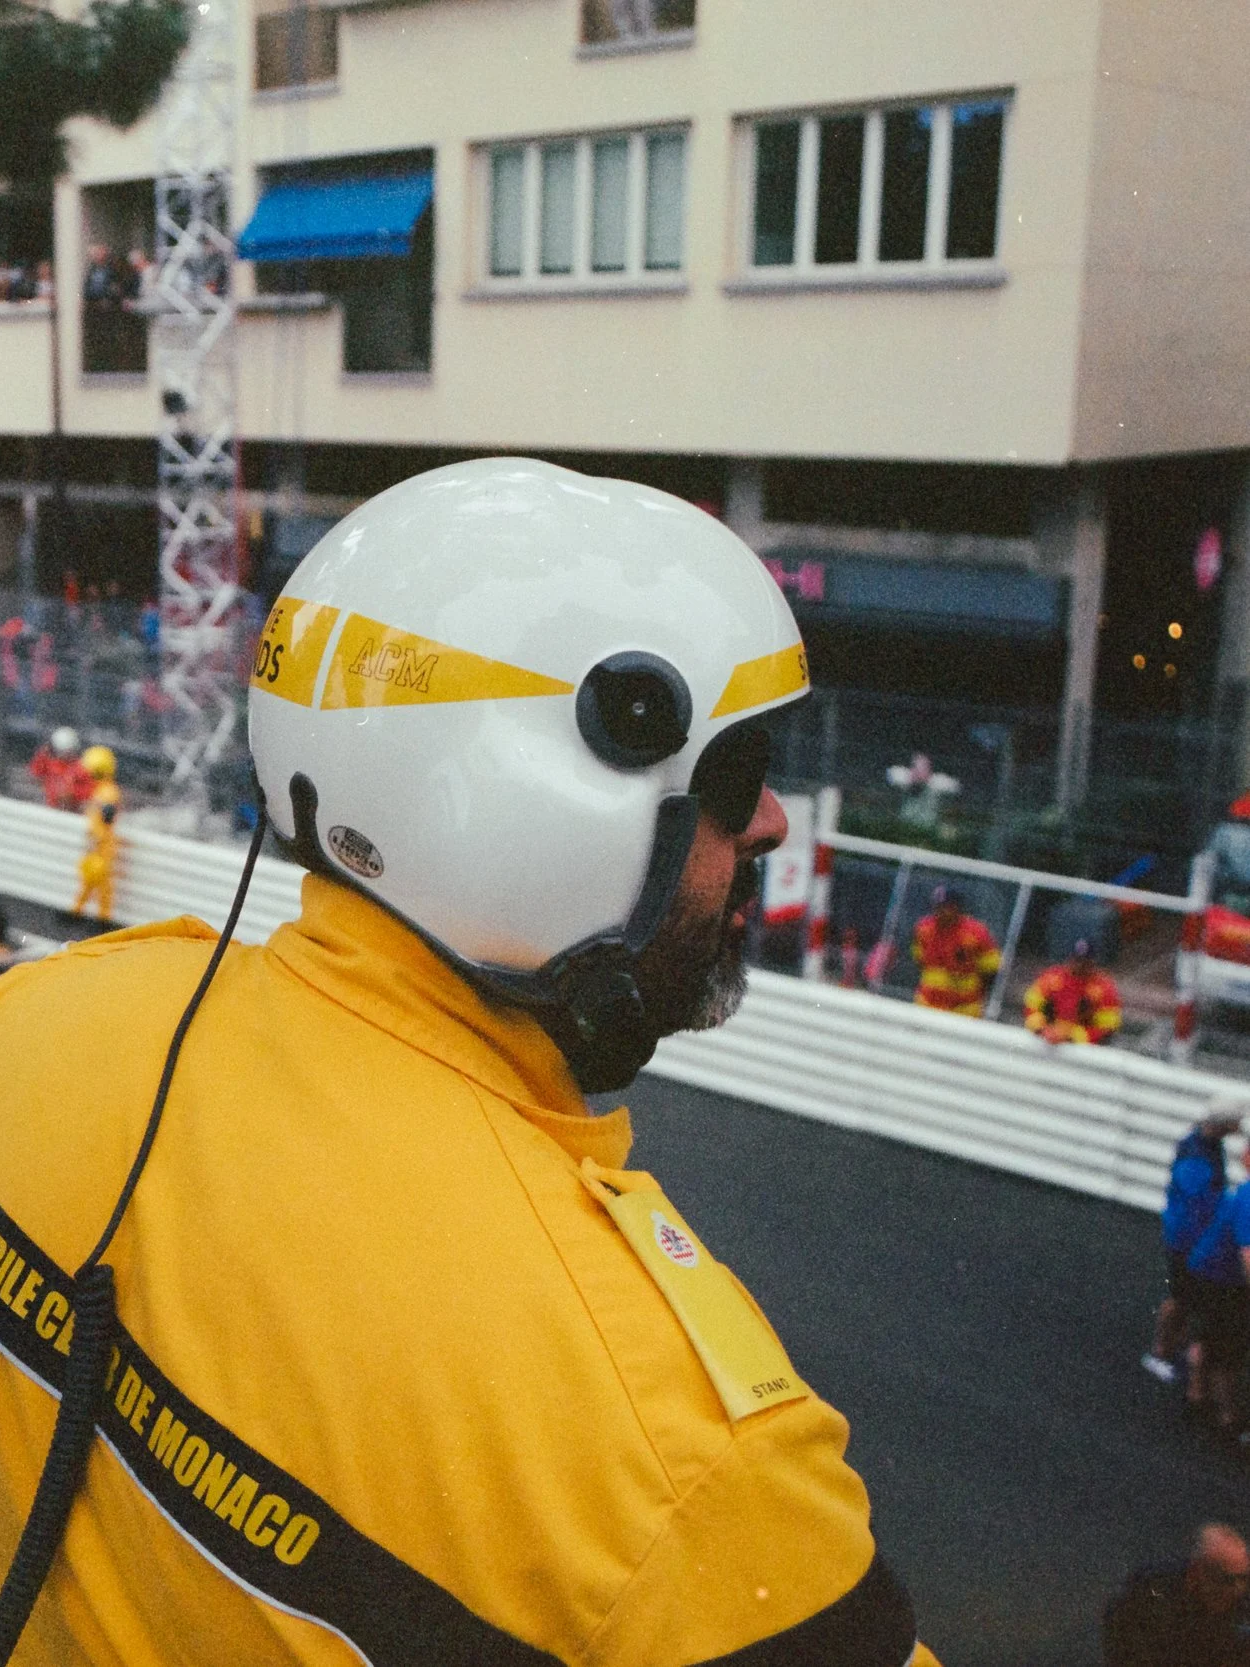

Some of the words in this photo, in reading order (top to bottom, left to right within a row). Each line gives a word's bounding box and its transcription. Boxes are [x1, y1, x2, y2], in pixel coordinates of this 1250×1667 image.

[349, 637, 440, 693] ACM
[751, 1377, 790, 1399] STAND
[113, 1364, 156, 1438] DE
[146, 1405, 321, 1566] MONACO
